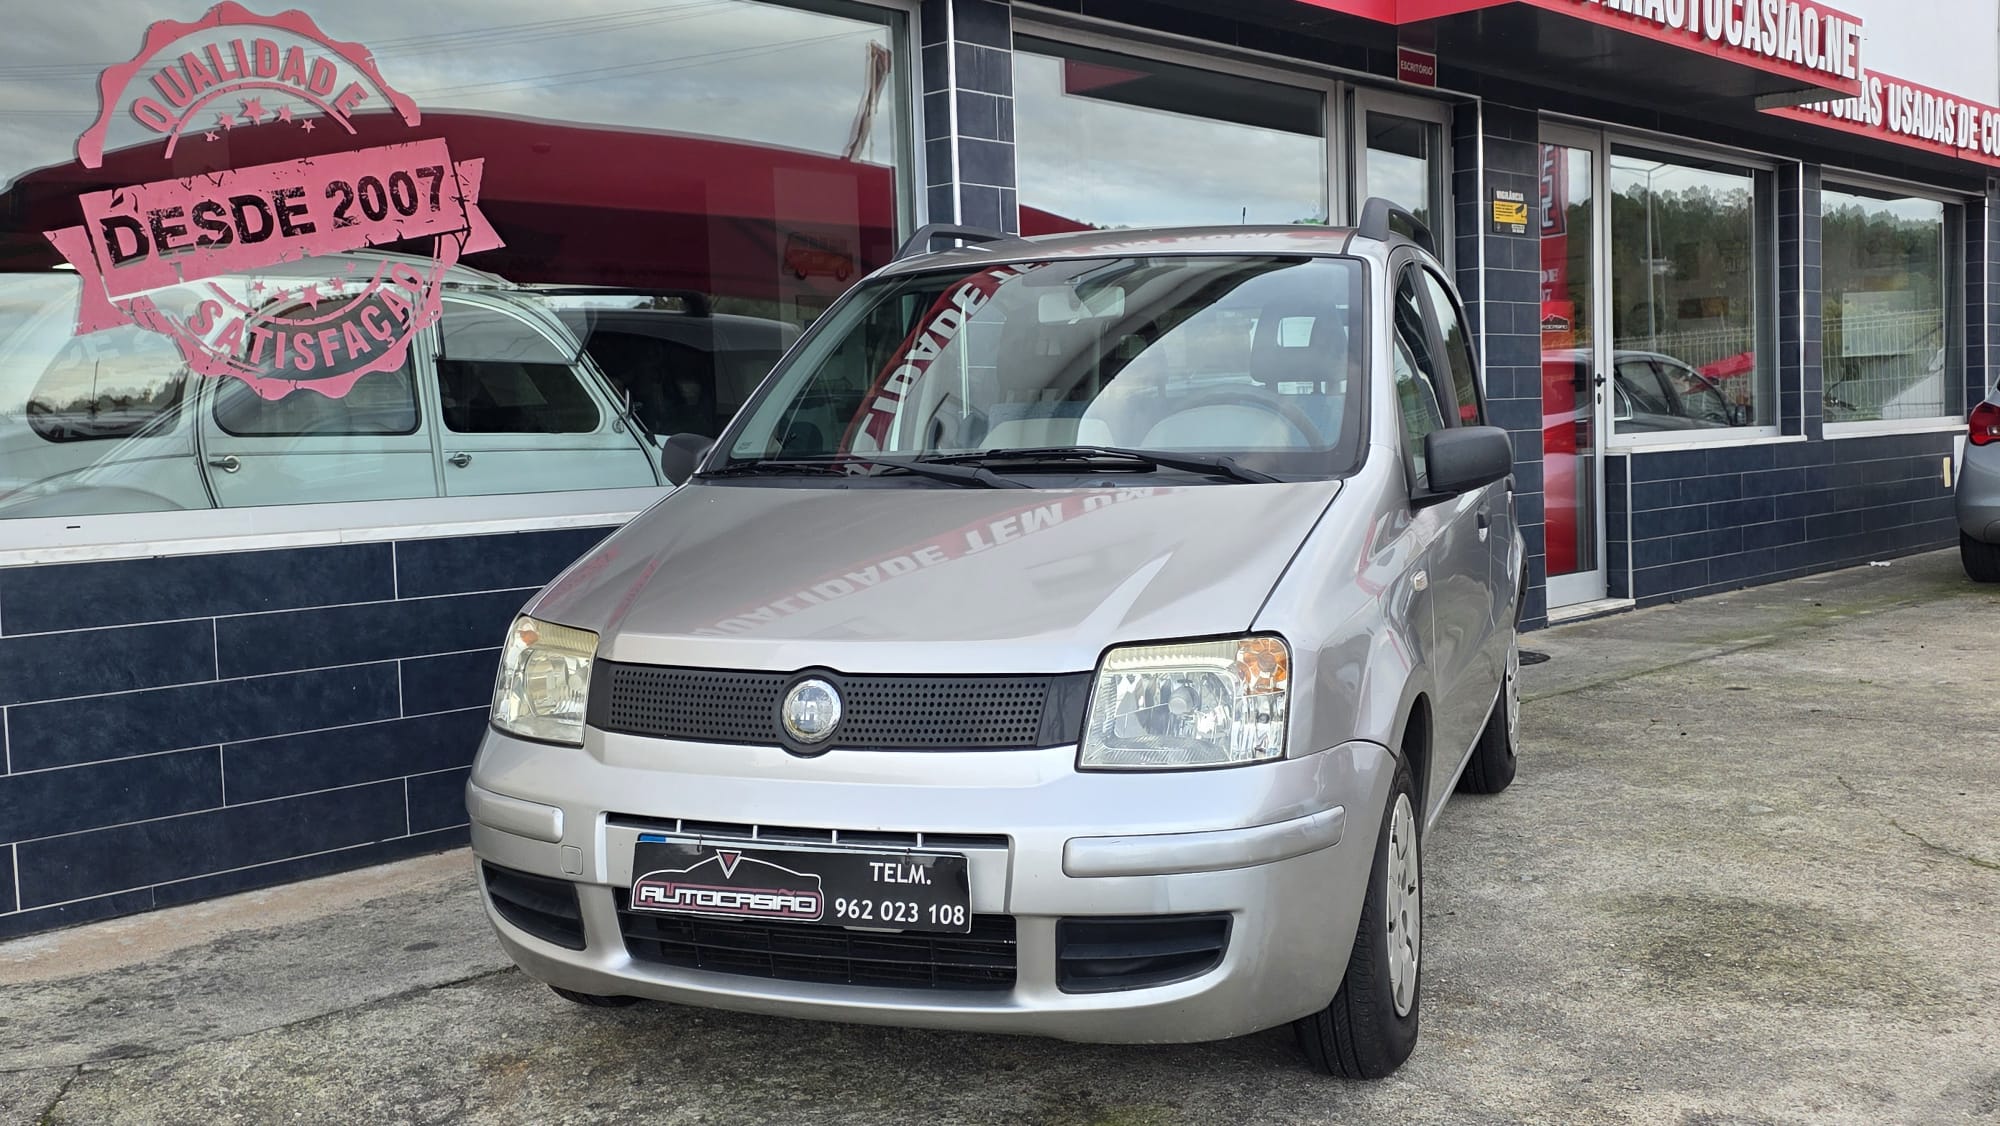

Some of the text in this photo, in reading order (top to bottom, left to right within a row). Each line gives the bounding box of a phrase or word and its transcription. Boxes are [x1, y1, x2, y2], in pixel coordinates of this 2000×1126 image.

[1400, 60, 1434, 76] ESCRITÓRIO
[130, 38, 370, 133] QUALIDADE
[1887, 82, 1955, 145] USADAS
[1957, 103, 1979, 150] DE
[100, 165, 446, 268] DESDE 2007
[869, 862, 932, 885] TELM.
[640, 886, 817, 912] AUTOCASIÃO
[835, 898, 965, 926] 962 023 108
